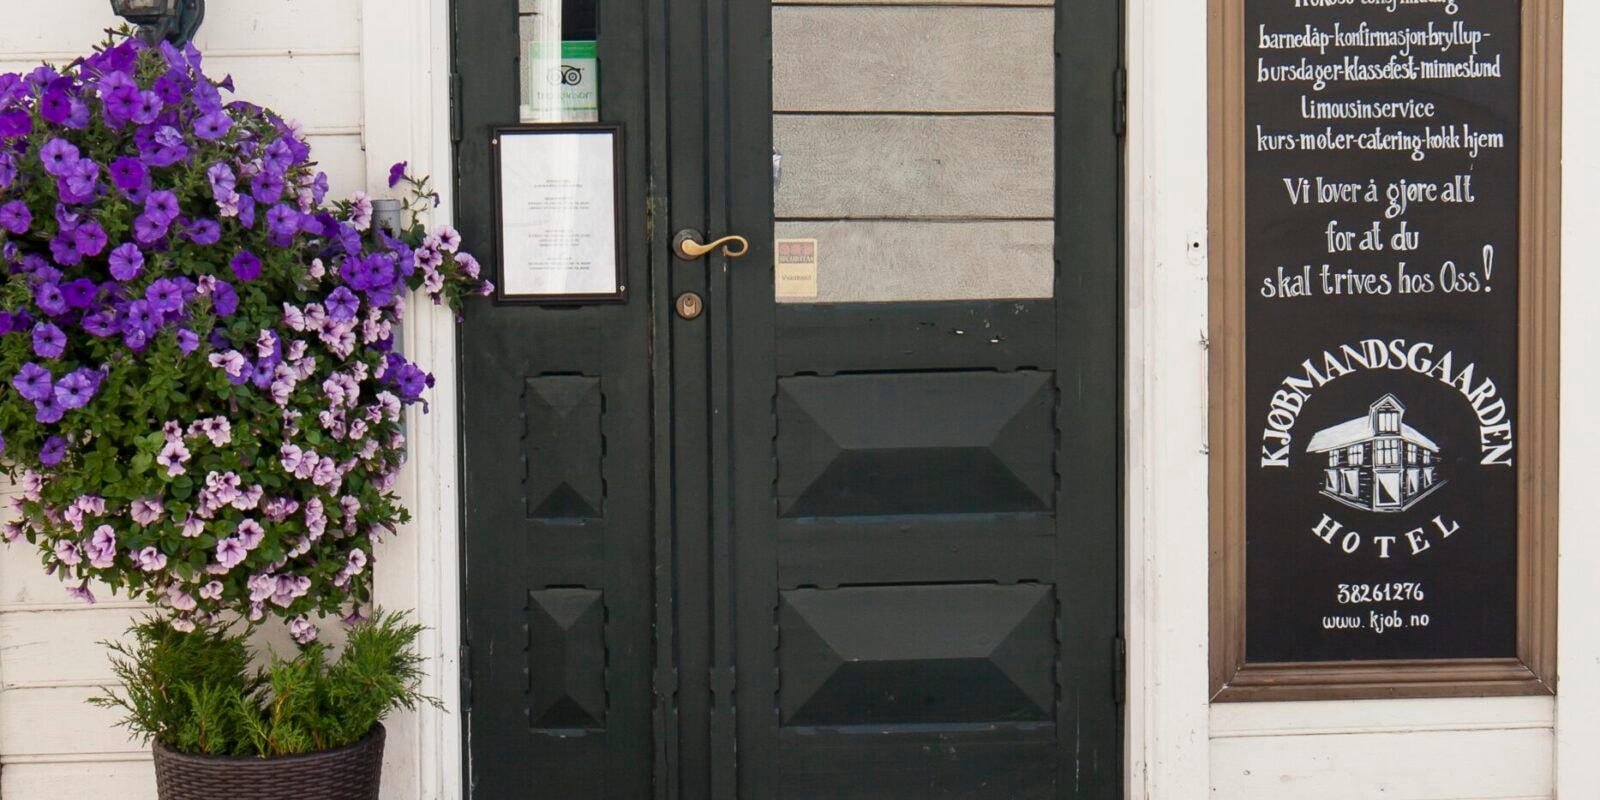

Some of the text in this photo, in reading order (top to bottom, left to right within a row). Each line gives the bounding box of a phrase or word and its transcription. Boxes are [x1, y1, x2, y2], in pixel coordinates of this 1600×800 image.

[1463, 124, 1504, 158] hjem
[1282, 177, 1311, 205] Vi
[1315, 176, 1362, 203] lover
[1384, 178, 1438, 219] gjøre
[1440, 174, 1475, 203] alt
[1324, 220, 1420, 253] for at du
[1260, 244, 1494, 298] skal trives hos Oss!
[1260, 338, 1513, 468] KJØBMANDSGAARDEN
[1311, 513, 1460, 558] HOTEL
[1337, 582, 1424, 604] 38261276
